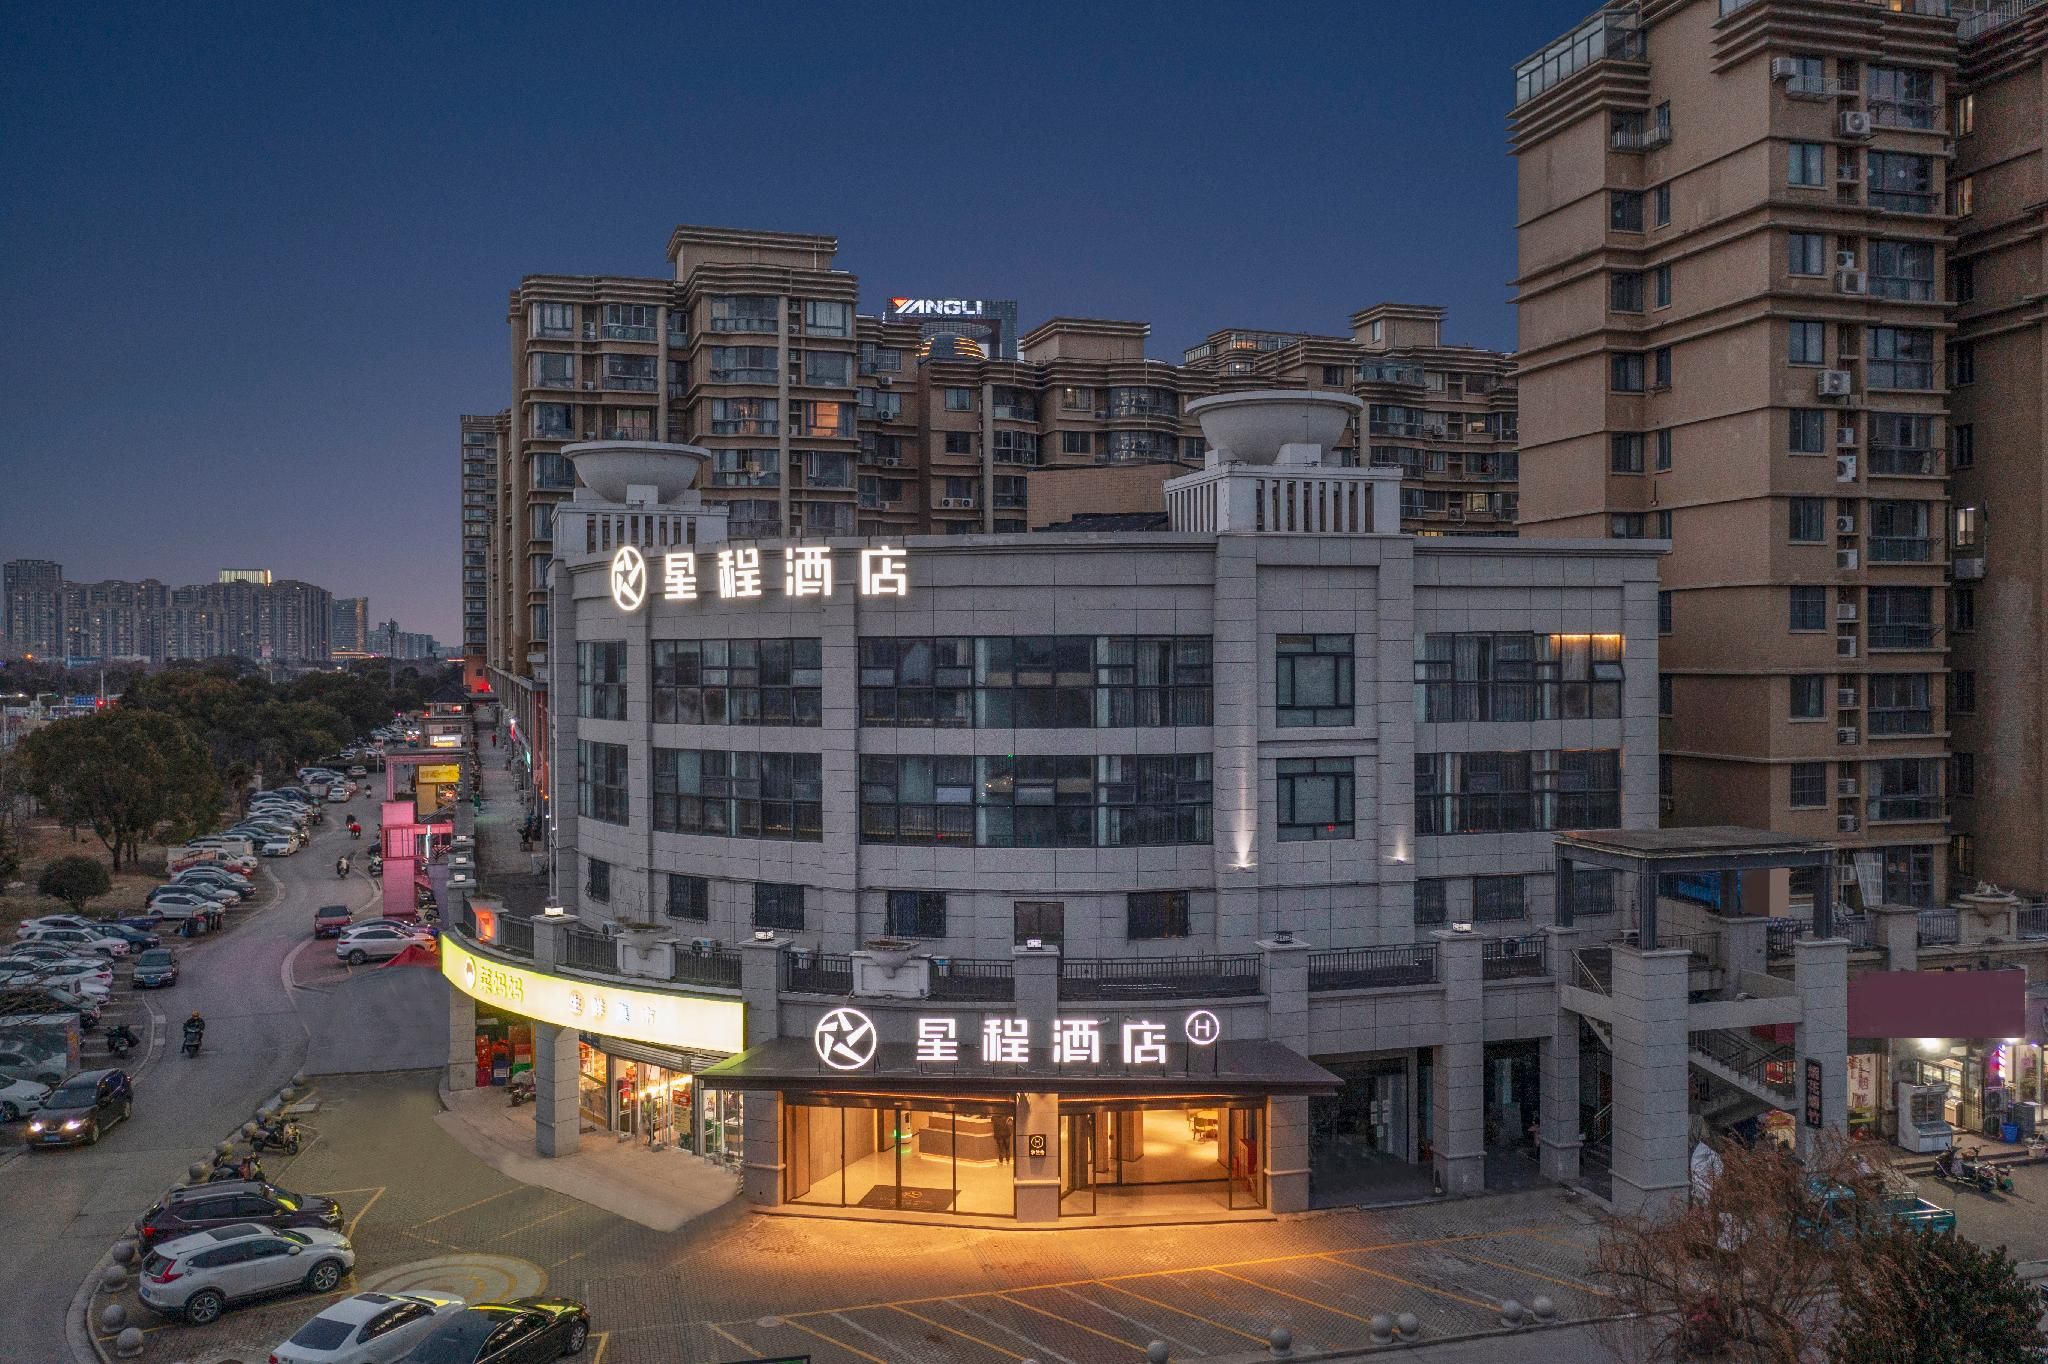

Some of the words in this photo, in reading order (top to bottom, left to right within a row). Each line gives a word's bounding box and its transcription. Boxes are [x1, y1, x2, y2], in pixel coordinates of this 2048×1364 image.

[892, 297, 982, 315] YANGLI
[664, 545, 907, 600] 星程酒店
[916, 1018, 1166, 1064] 星程酒店
